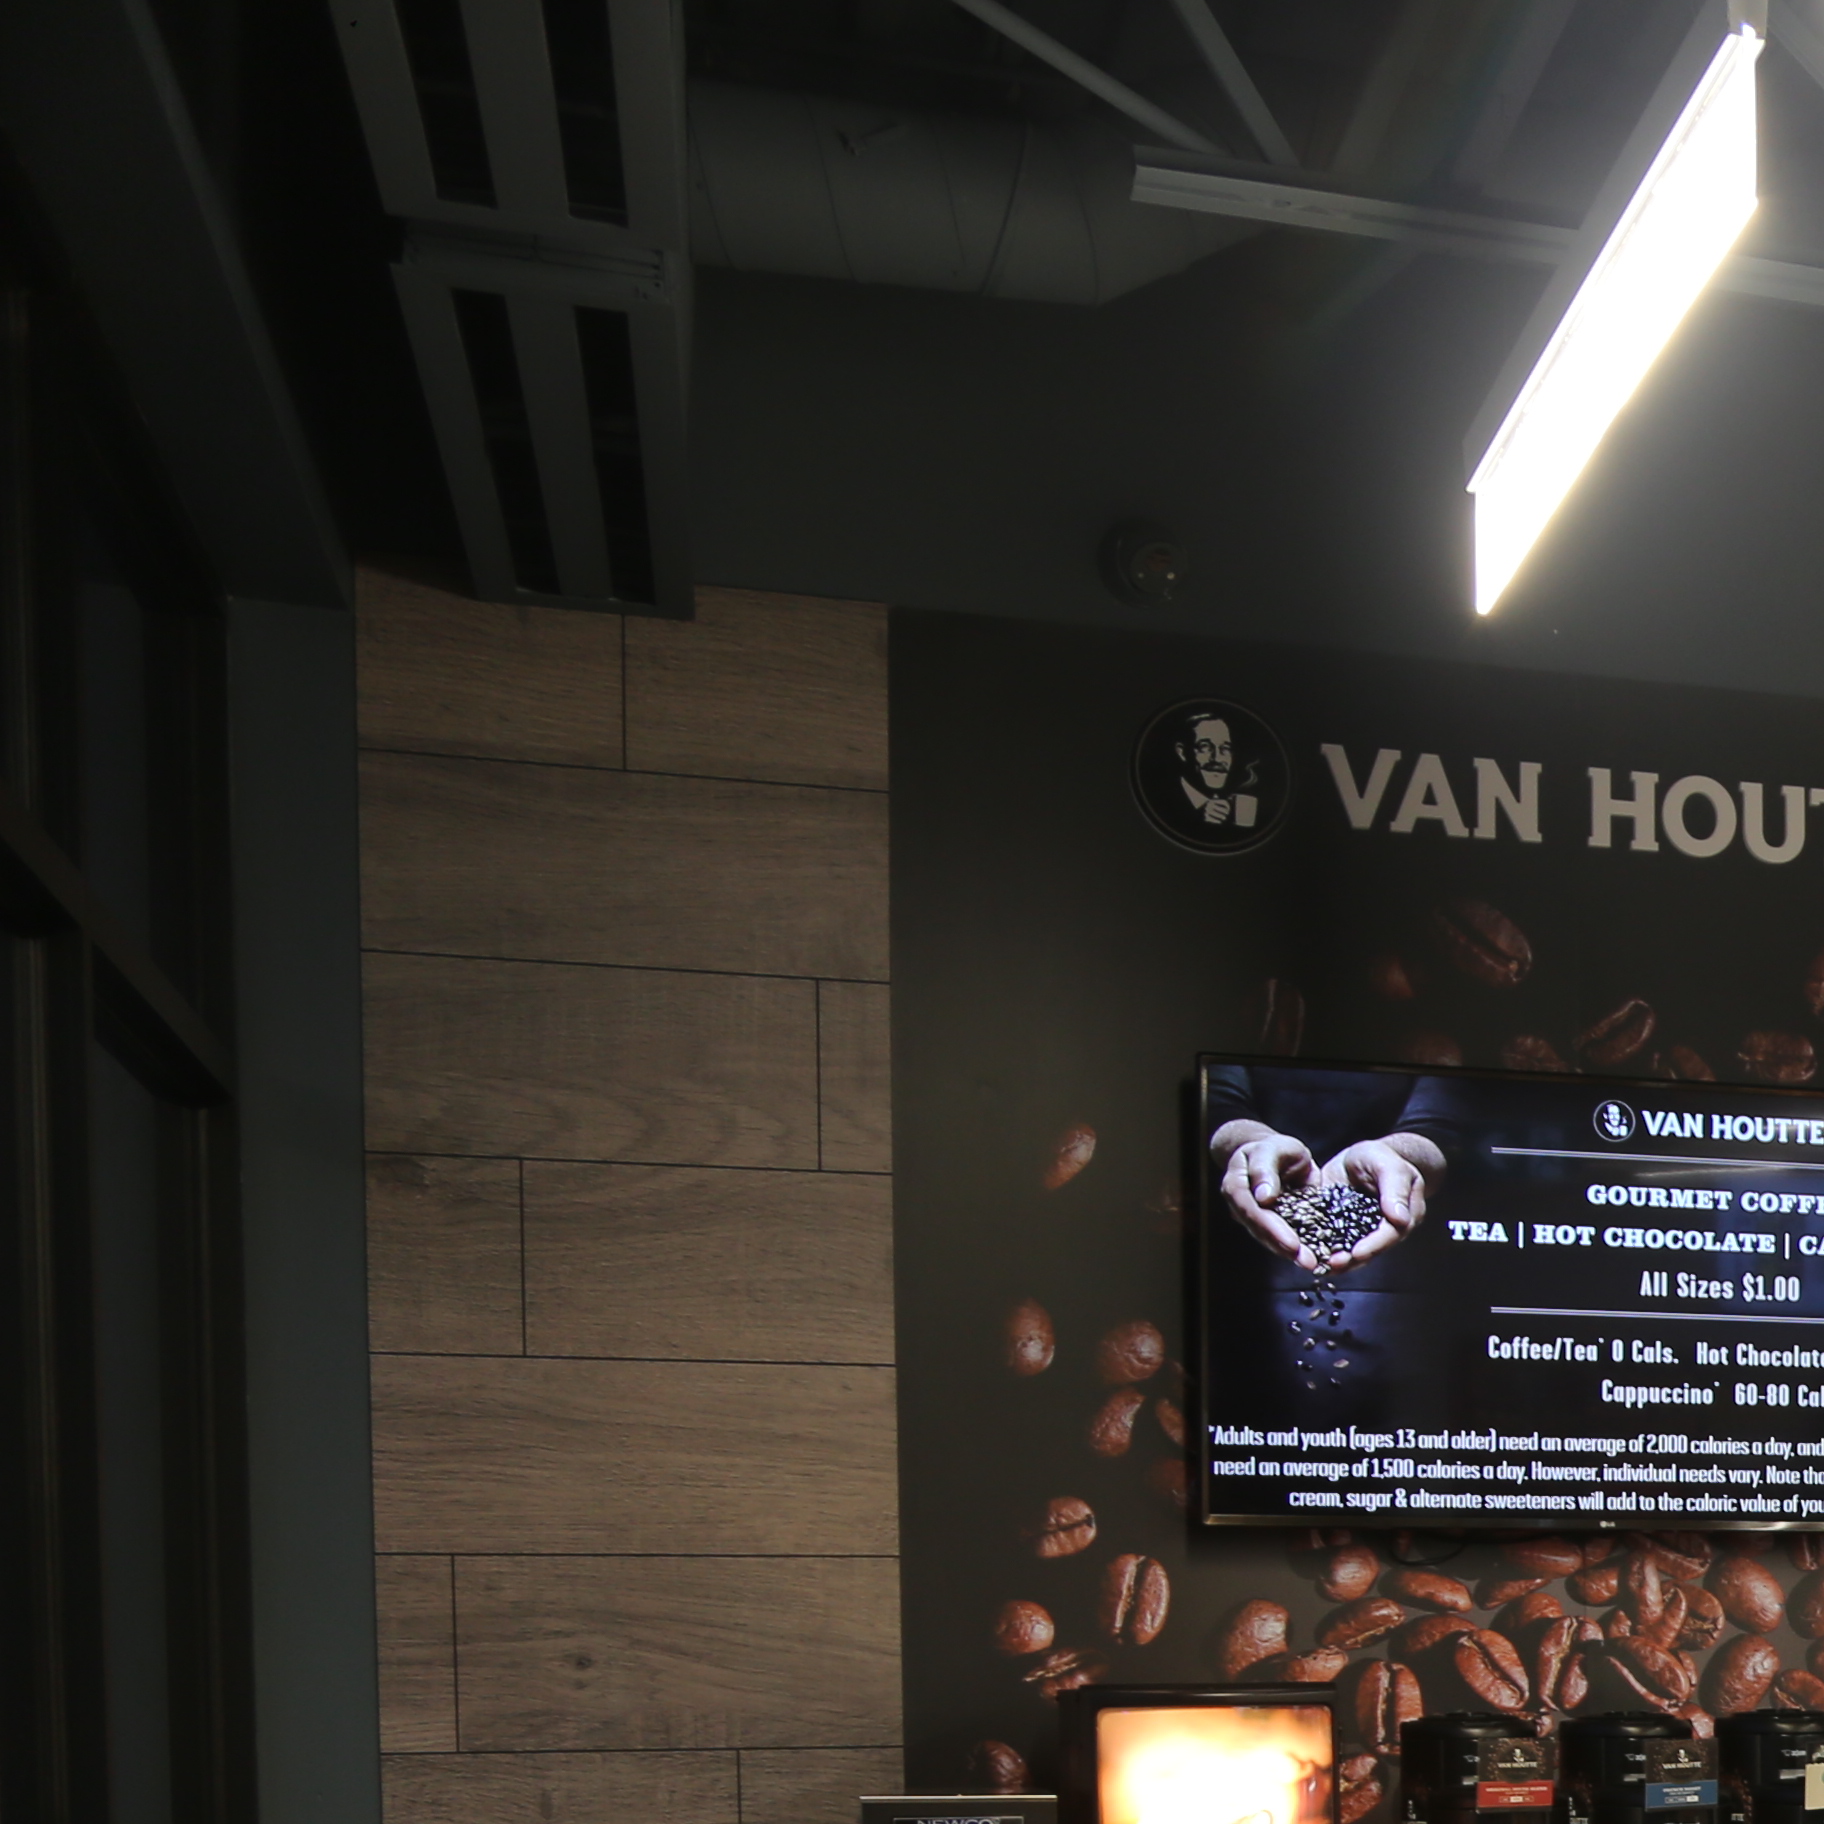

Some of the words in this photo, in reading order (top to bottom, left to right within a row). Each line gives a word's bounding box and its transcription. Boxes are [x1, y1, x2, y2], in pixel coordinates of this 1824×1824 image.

[1321, 743, 1542, 843] VAN
[1642, 1110, 1704, 1138] VAN
[1586, 1184, 1733, 1211] GOURMET
[1448, 1220, 1508, 1243] TEA
[1533, 1225, 1596, 1247] HOT
[1603, 1227, 1776, 1254] CHOCOLATE
[1640, 1270, 1668, 1298] All
[1676, 1273, 1733, 1300] Sizes
[1743, 1272, 1800, 1302] $1.00
[1611, 1340, 1624, 1362] 0
[1632, 1340, 1679, 1364] Cals.
[1697, 1342, 1728, 1365] Hot
[1735, 1383, 1790, 1407] 60-80
[1267, 1427, 1298, 1446] and
[1301, 1428, 1346, 1451] youth
[1350, 1426, 1394, 1451] (ages
[1396, 1429, 1416, 1448] 13
[1418, 1429, 1448, 1449] and
[1451, 1428, 1496, 1452] older)
[1499, 1432, 1539, 1450] need
[1541, 1437, 1562, 1451] an
[1564, 1436, 1626, 1455] average
[1629, 1436, 1646, 1453] of
[1647, 1434, 1688, 1455] 2,000
[1690, 1436, 1750, 1455] calories
[1752, 1441, 1762, 1455] a
[1797, 1438, 1824, 1457] and
[1213, 1457, 1256, 1476] need
[1259, 1462, 1281, 1476] an
[1283, 1462, 1349, 1481] average
[1352, 1458, 1369, 1477] of
[1371, 1459, 1414, 1479] 1,500
[1416, 1459, 1480, 1479] calories
[1483, 1465, 1494, 1479] a
[1496, 1461, 1528, 1484] day.
[1603, 1464, 1676, 1482] individual
[1679, 1465, 1726, 1483] needs
[1728, 1470, 1763, 1488] vary.
[1766, 1466, 1800, 1485] Note
[1346, 1493, 1392, 1512] sugar
[1394, 1488, 1407, 1506] &
[1410, 1488, 1482, 1508] alternate
[1485, 1493, 1575, 1510] sweeteners
[1578, 1493, 1604, 1510] will
[1607, 1492, 1636, 1510] add
[1639, 1493, 1656, 1510] to
[1658, 1492, 1683, 1511] the
[1686, 1493, 1737, 1512] caloric
[1740, 1494, 1779, 1512] value
[1782, 1494, 1799, 1512] of
